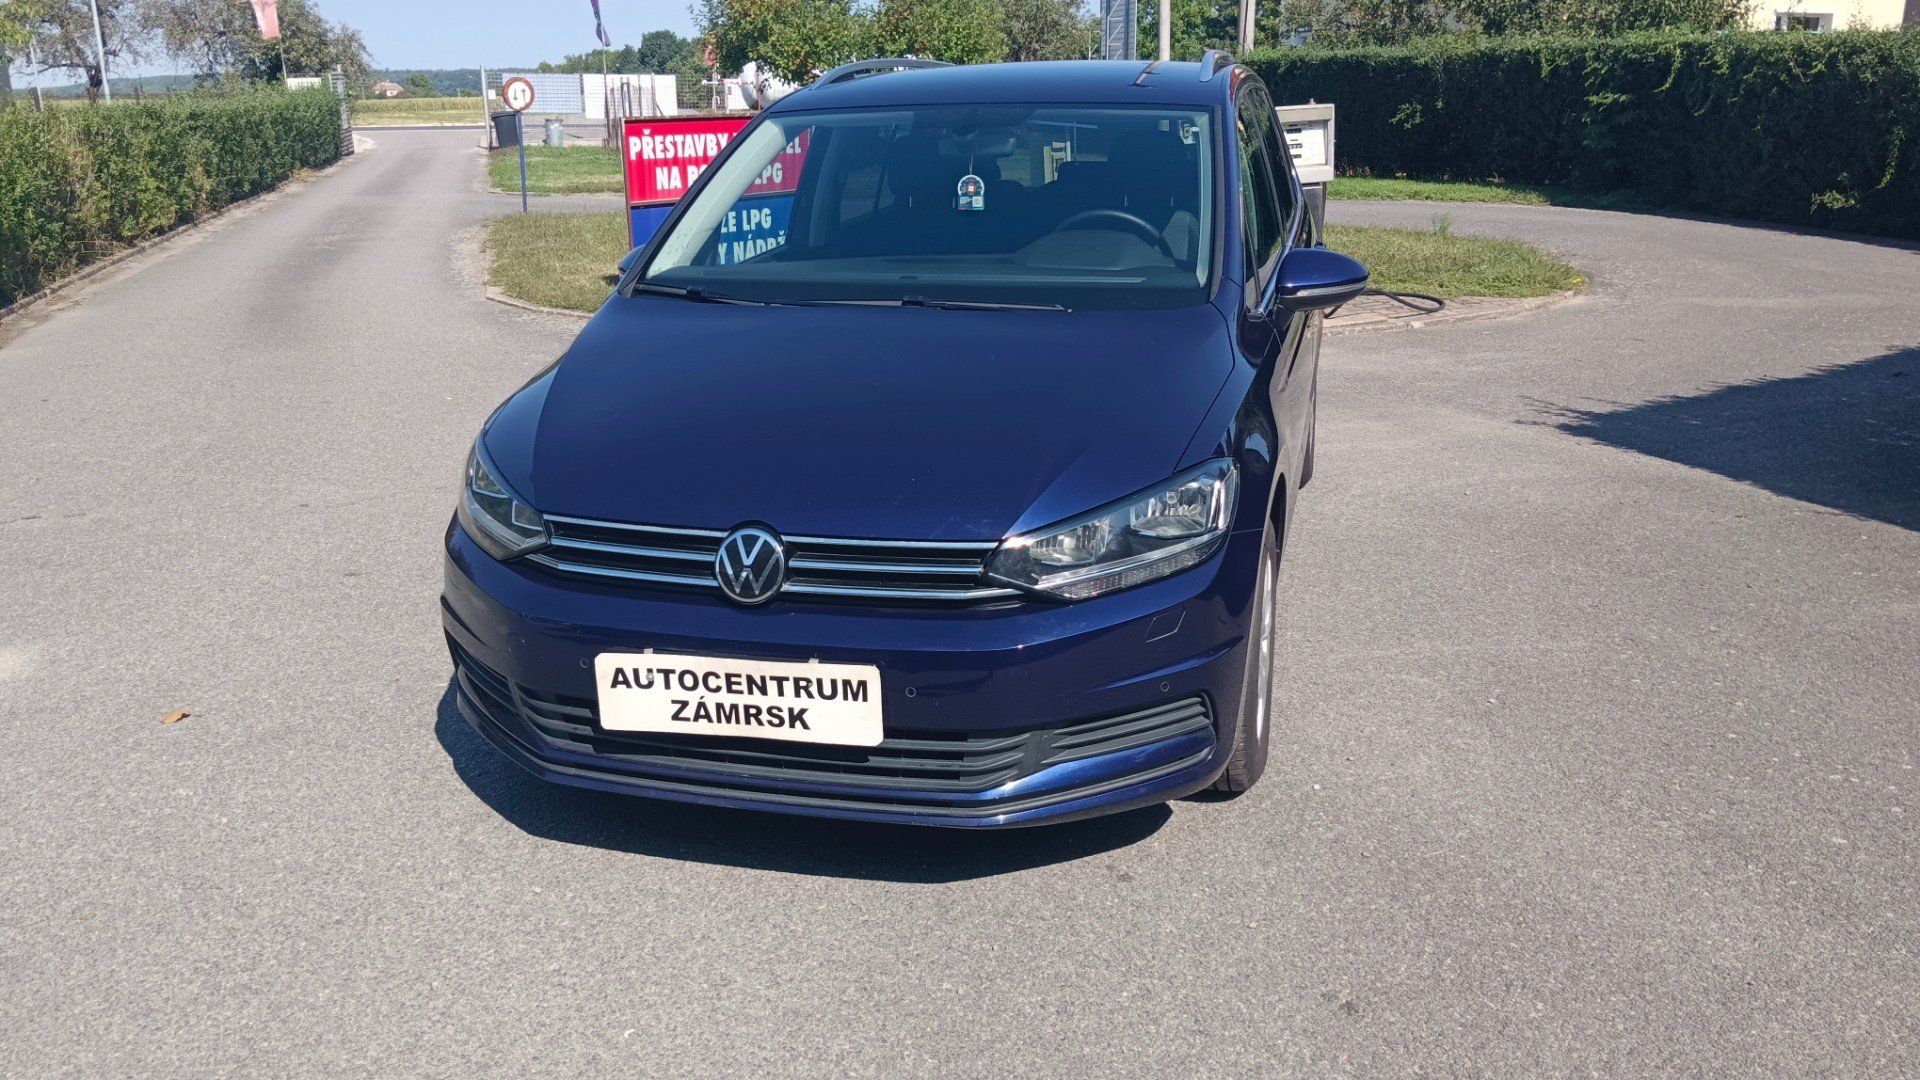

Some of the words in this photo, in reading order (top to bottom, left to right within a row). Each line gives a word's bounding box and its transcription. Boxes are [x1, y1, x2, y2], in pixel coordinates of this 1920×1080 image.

[629, 129, 729, 160] PŘESTAVBY
[655, 166, 683, 191] NA
[742, 208, 772, 230] LPG
[610, 667, 869, 703] AUTOCENTRUM
[670, 696, 811, 730] ZÁMRSK
